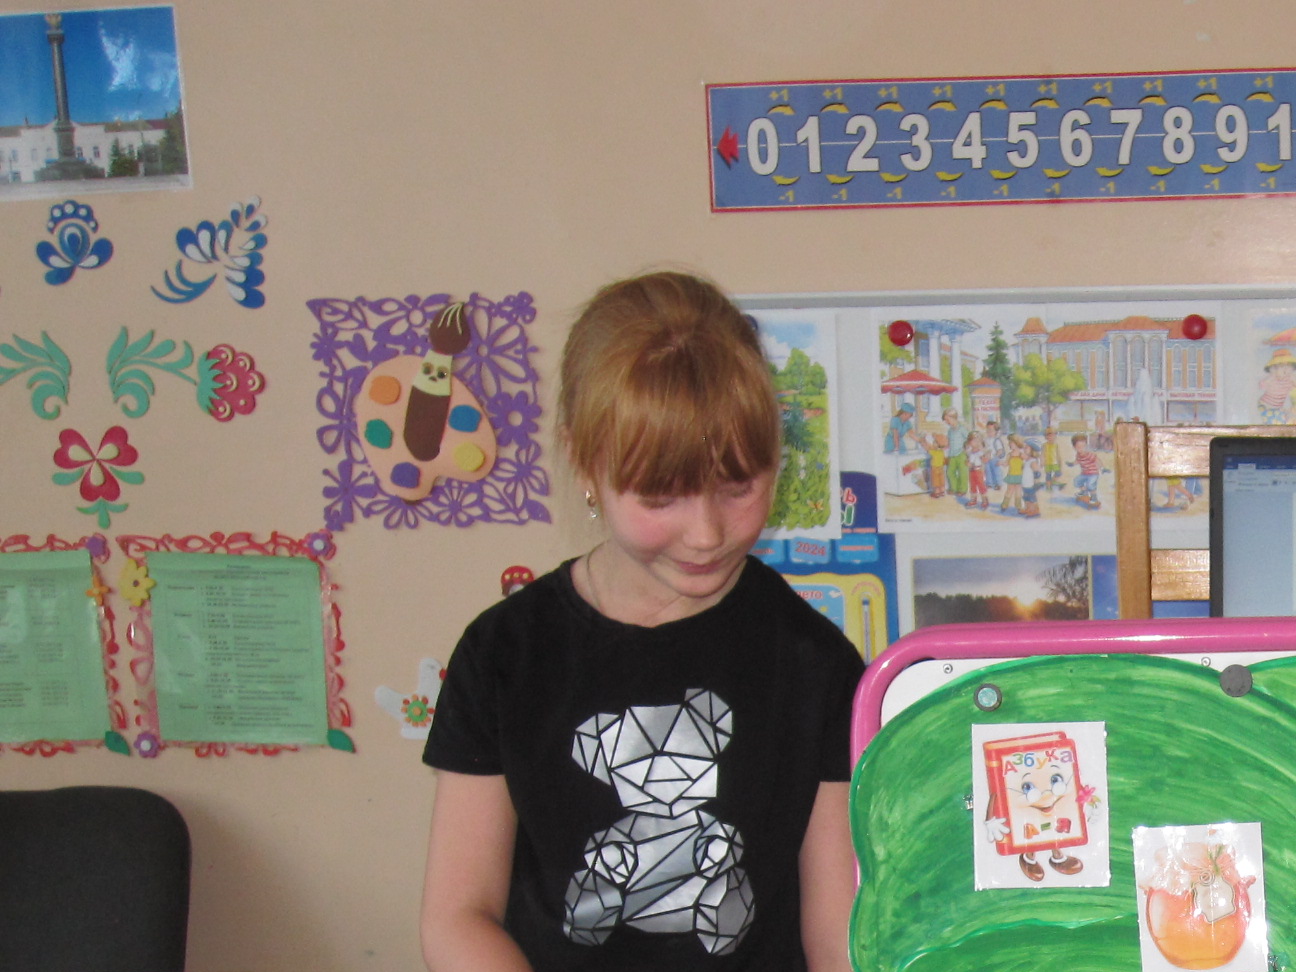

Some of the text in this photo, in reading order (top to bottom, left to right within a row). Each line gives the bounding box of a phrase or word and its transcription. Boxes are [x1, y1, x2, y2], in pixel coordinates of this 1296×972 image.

[747, 117, 779, 175] 0
[796, 115, 821, 173] 1
[846, 114, 880, 172] 2
[900, 113, 932, 171] 3
[952, 111, 987, 168] 4
[1006, 111, 1039, 168] 5
[1059, 109, 1093, 167] 6
[1110, 108, 1143, 165] 7
[1162, 106, 1195, 164] 8
[1215, 104, 1248, 163] 9
[796, 541, 826, 556] 2024
